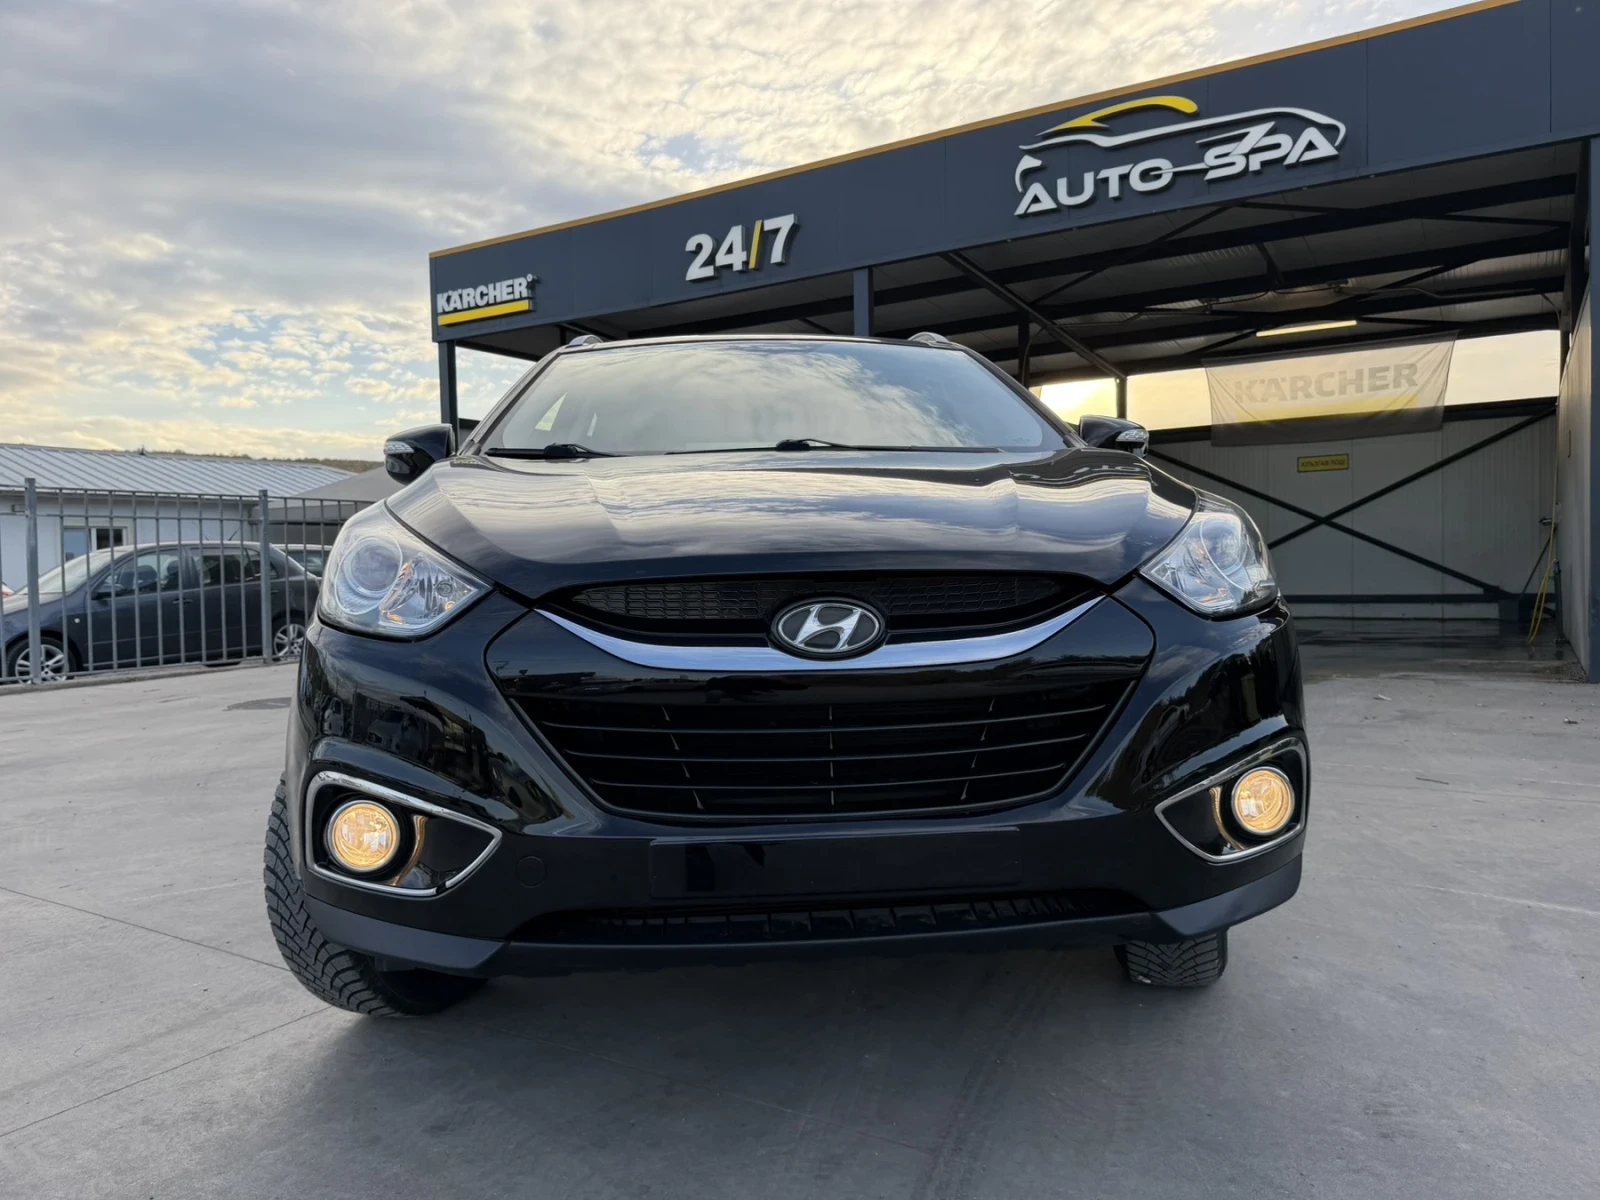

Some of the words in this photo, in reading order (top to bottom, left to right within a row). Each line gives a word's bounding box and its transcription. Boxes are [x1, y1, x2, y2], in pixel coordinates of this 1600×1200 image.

[1014, 157, 1174, 216] AUTO
[1203, 121, 1339, 181] SPA
[685, 213, 796, 281] 24/7
[436, 275, 531, 314] KÄRCHER
[1234, 362, 1419, 404] KÄRCHER
